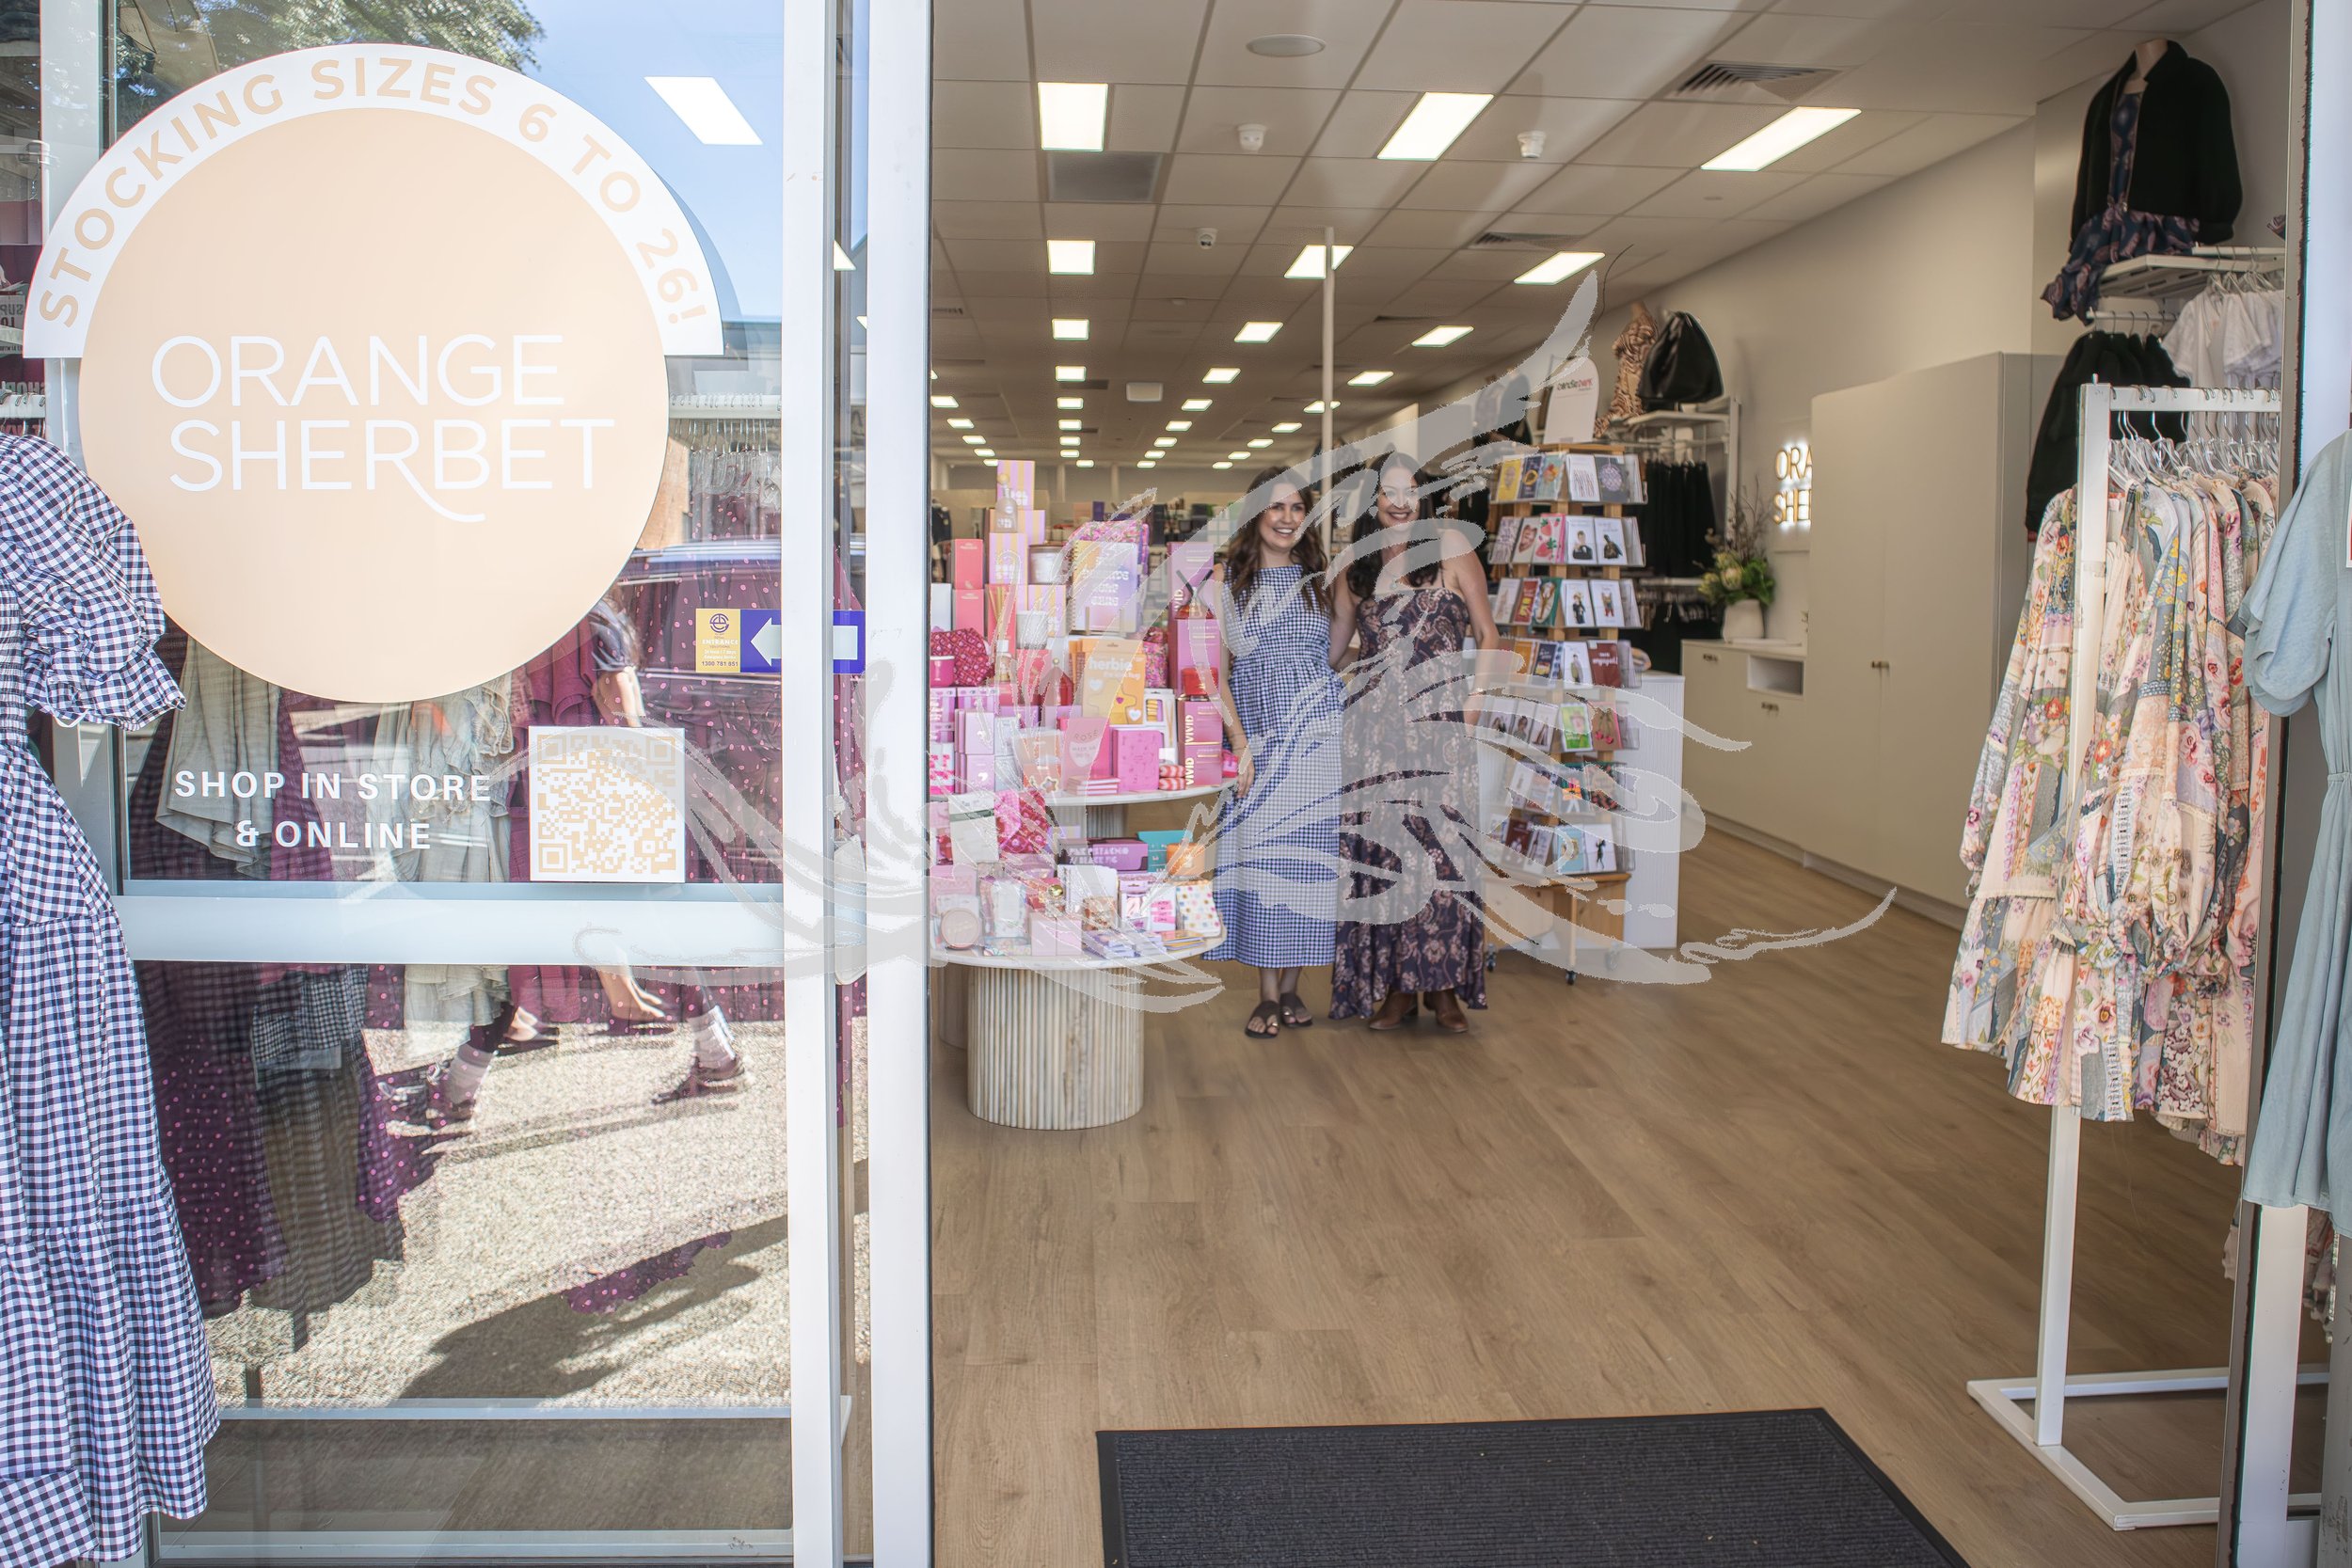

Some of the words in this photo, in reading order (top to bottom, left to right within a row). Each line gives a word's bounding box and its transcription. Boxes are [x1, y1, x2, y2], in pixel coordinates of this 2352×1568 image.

[39, 73, 285, 329] STOCKING
[311, 56, 499, 116] SIZES
[518, 103, 557, 143] 6
[571, 134, 641, 214] TO
[638, 228, 707, 325] 26!
[151, 334, 564, 408] ORANGE
[169, 418, 615, 523] SHERBET
[1772, 489, 1812, 525] SHE
[1184, 714, 1195, 744] VIVID
[174, 770, 286, 799] SHOP
[301, 772, 342, 800] IN
[358, 773, 491, 801] STORE
[1185, 757, 1195, 785] VIVID
[235, 819, 260, 847] &
[275, 820, 431, 849] ONLINE
